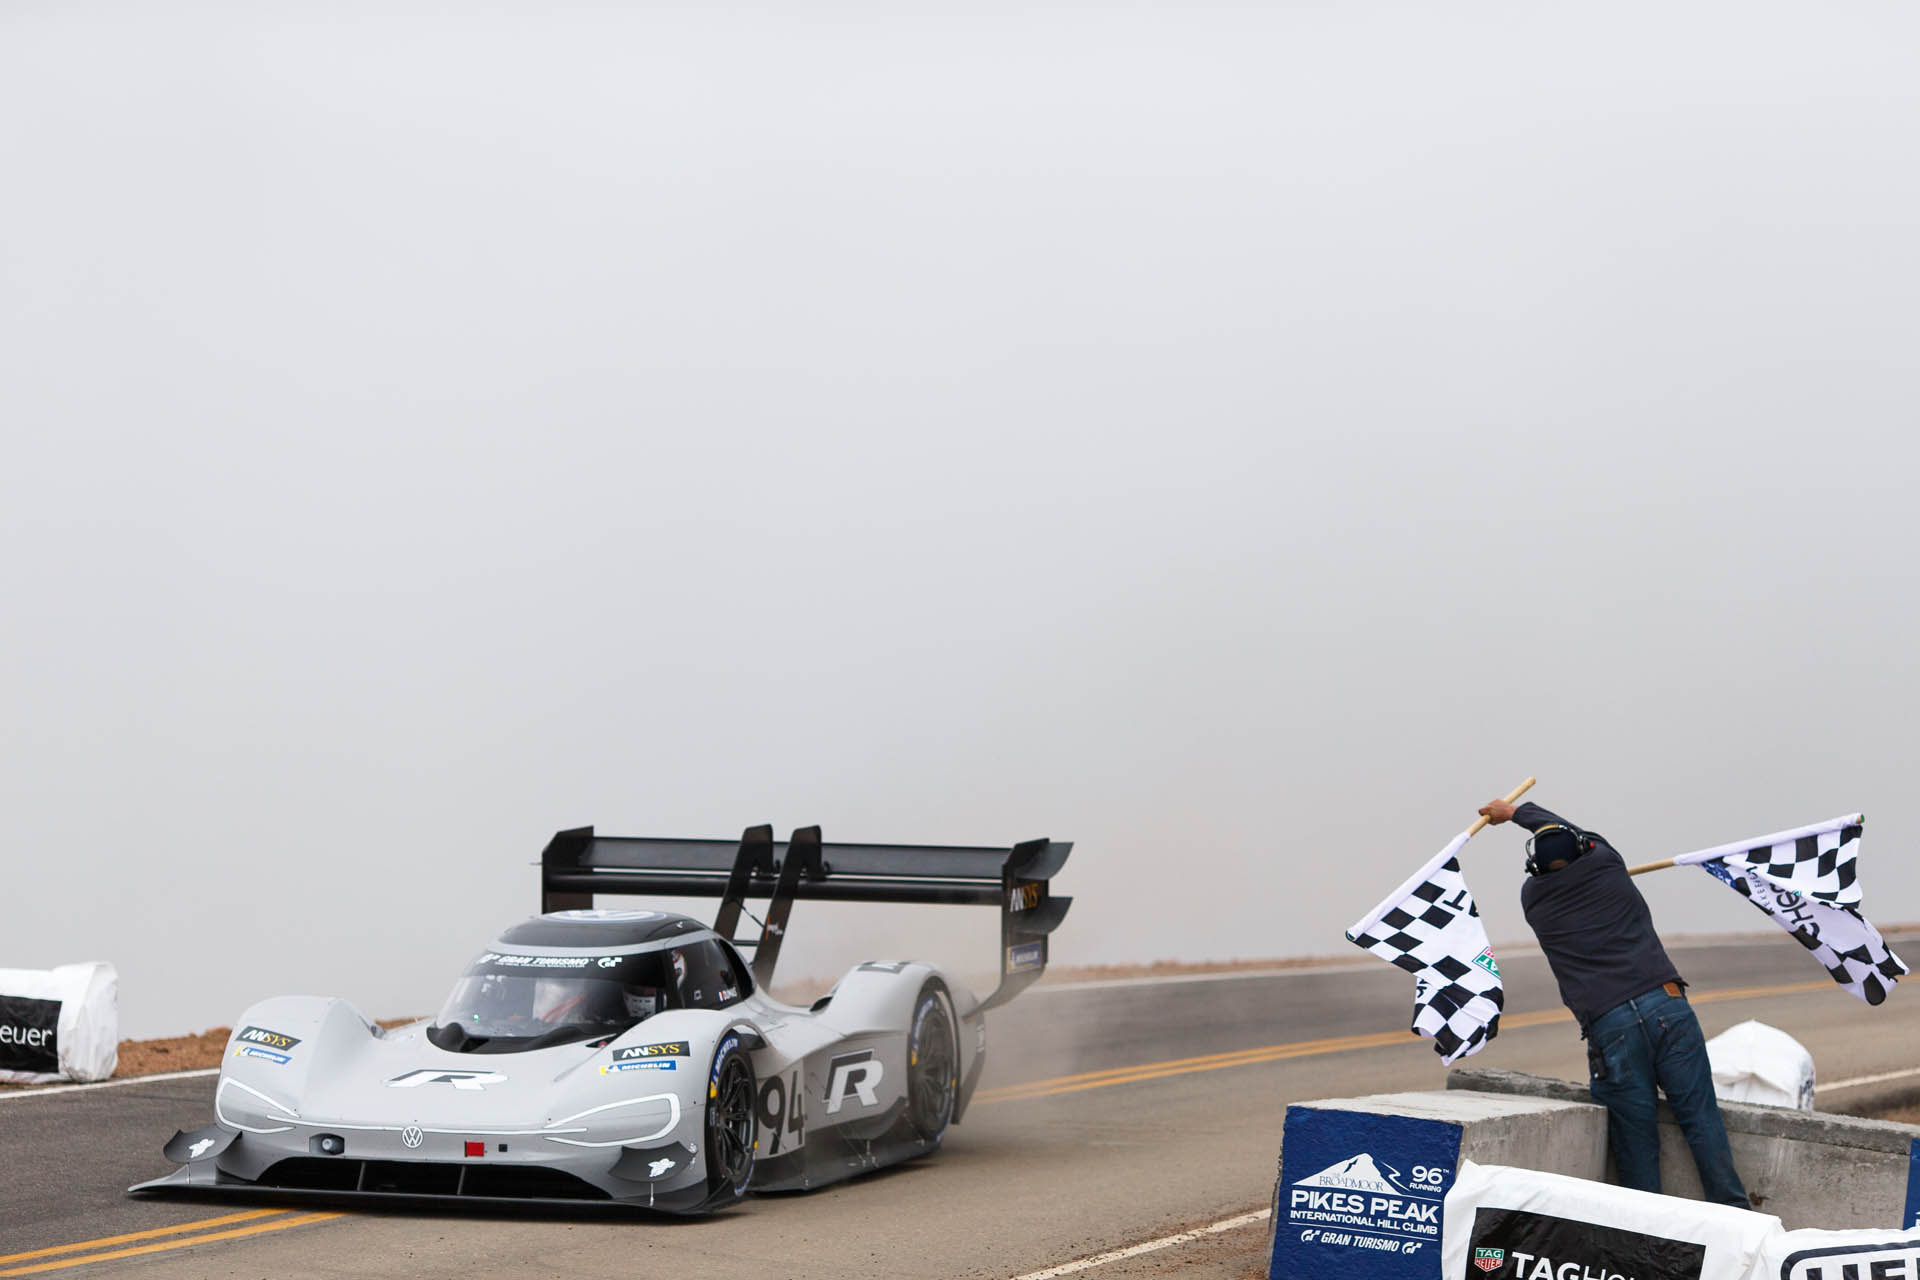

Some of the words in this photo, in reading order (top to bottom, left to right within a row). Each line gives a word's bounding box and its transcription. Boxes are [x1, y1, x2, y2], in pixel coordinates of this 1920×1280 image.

[1009, 882, 1039, 912] ANSYS
[242, 1030, 293, 1047] ANSYS
[621, 1044, 680, 1059] ANSYS
[621, 1062, 671, 1071] MICHELIN
[822, 1049, 884, 1115] R
[757, 1069, 804, 1155] 94
[1319, 1175, 1385, 1192] BROADMOOR
[1409, 1182, 1442, 1193] RUNNING
[1291, 1189, 1365, 1214] PIKES
[1370, 1197, 1439, 1224] PEAK
[1290, 1210, 1375, 1227] INTERNATIONAL
[1377, 1219, 1400, 1230] HILL
[1402, 1222, 1438, 1235] CLIMB
[1321, 1232, 1352, 1246] GRAN
[1353, 1235, 1400, 1252] TURISMO
[1479, 1249, 1502, 1258] TAG
[1475, 1257, 1502, 1270] HEUER
